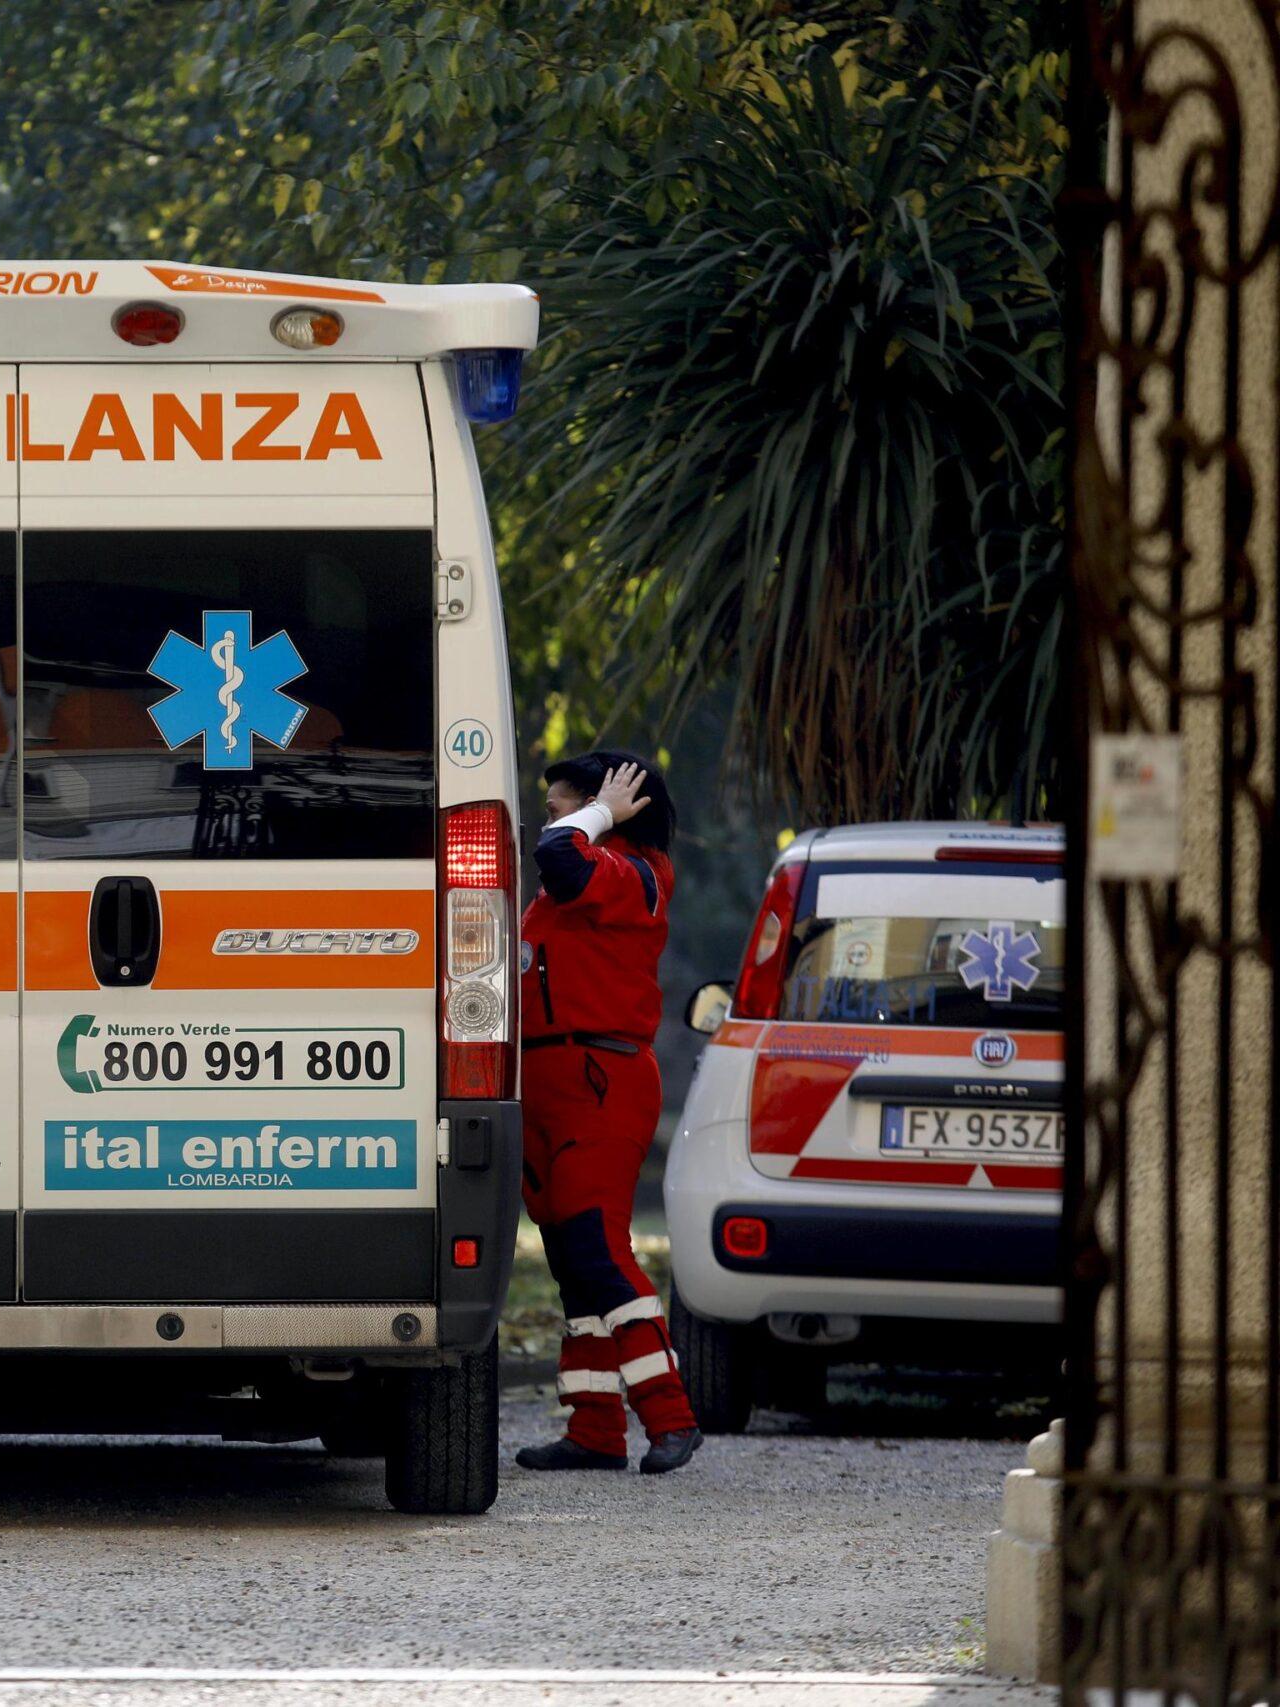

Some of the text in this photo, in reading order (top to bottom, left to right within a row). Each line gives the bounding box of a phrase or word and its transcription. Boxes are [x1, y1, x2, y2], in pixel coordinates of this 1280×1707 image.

[280, 708, 304, 746] ORION
[451, 729, 485, 757] 40
[216, 930, 418, 954] DUCATO
[107, 1023, 231, 1036] Numero Verde
[103, 1040, 391, 1081] 800 991 800
[983, 1041, 1007, 1059] FIAT
[909, 1111, 951, 1145] FX
[64, 1125, 397, 1169] ital enferm
[167, 1173, 293, 1187] LOMBARDIA
